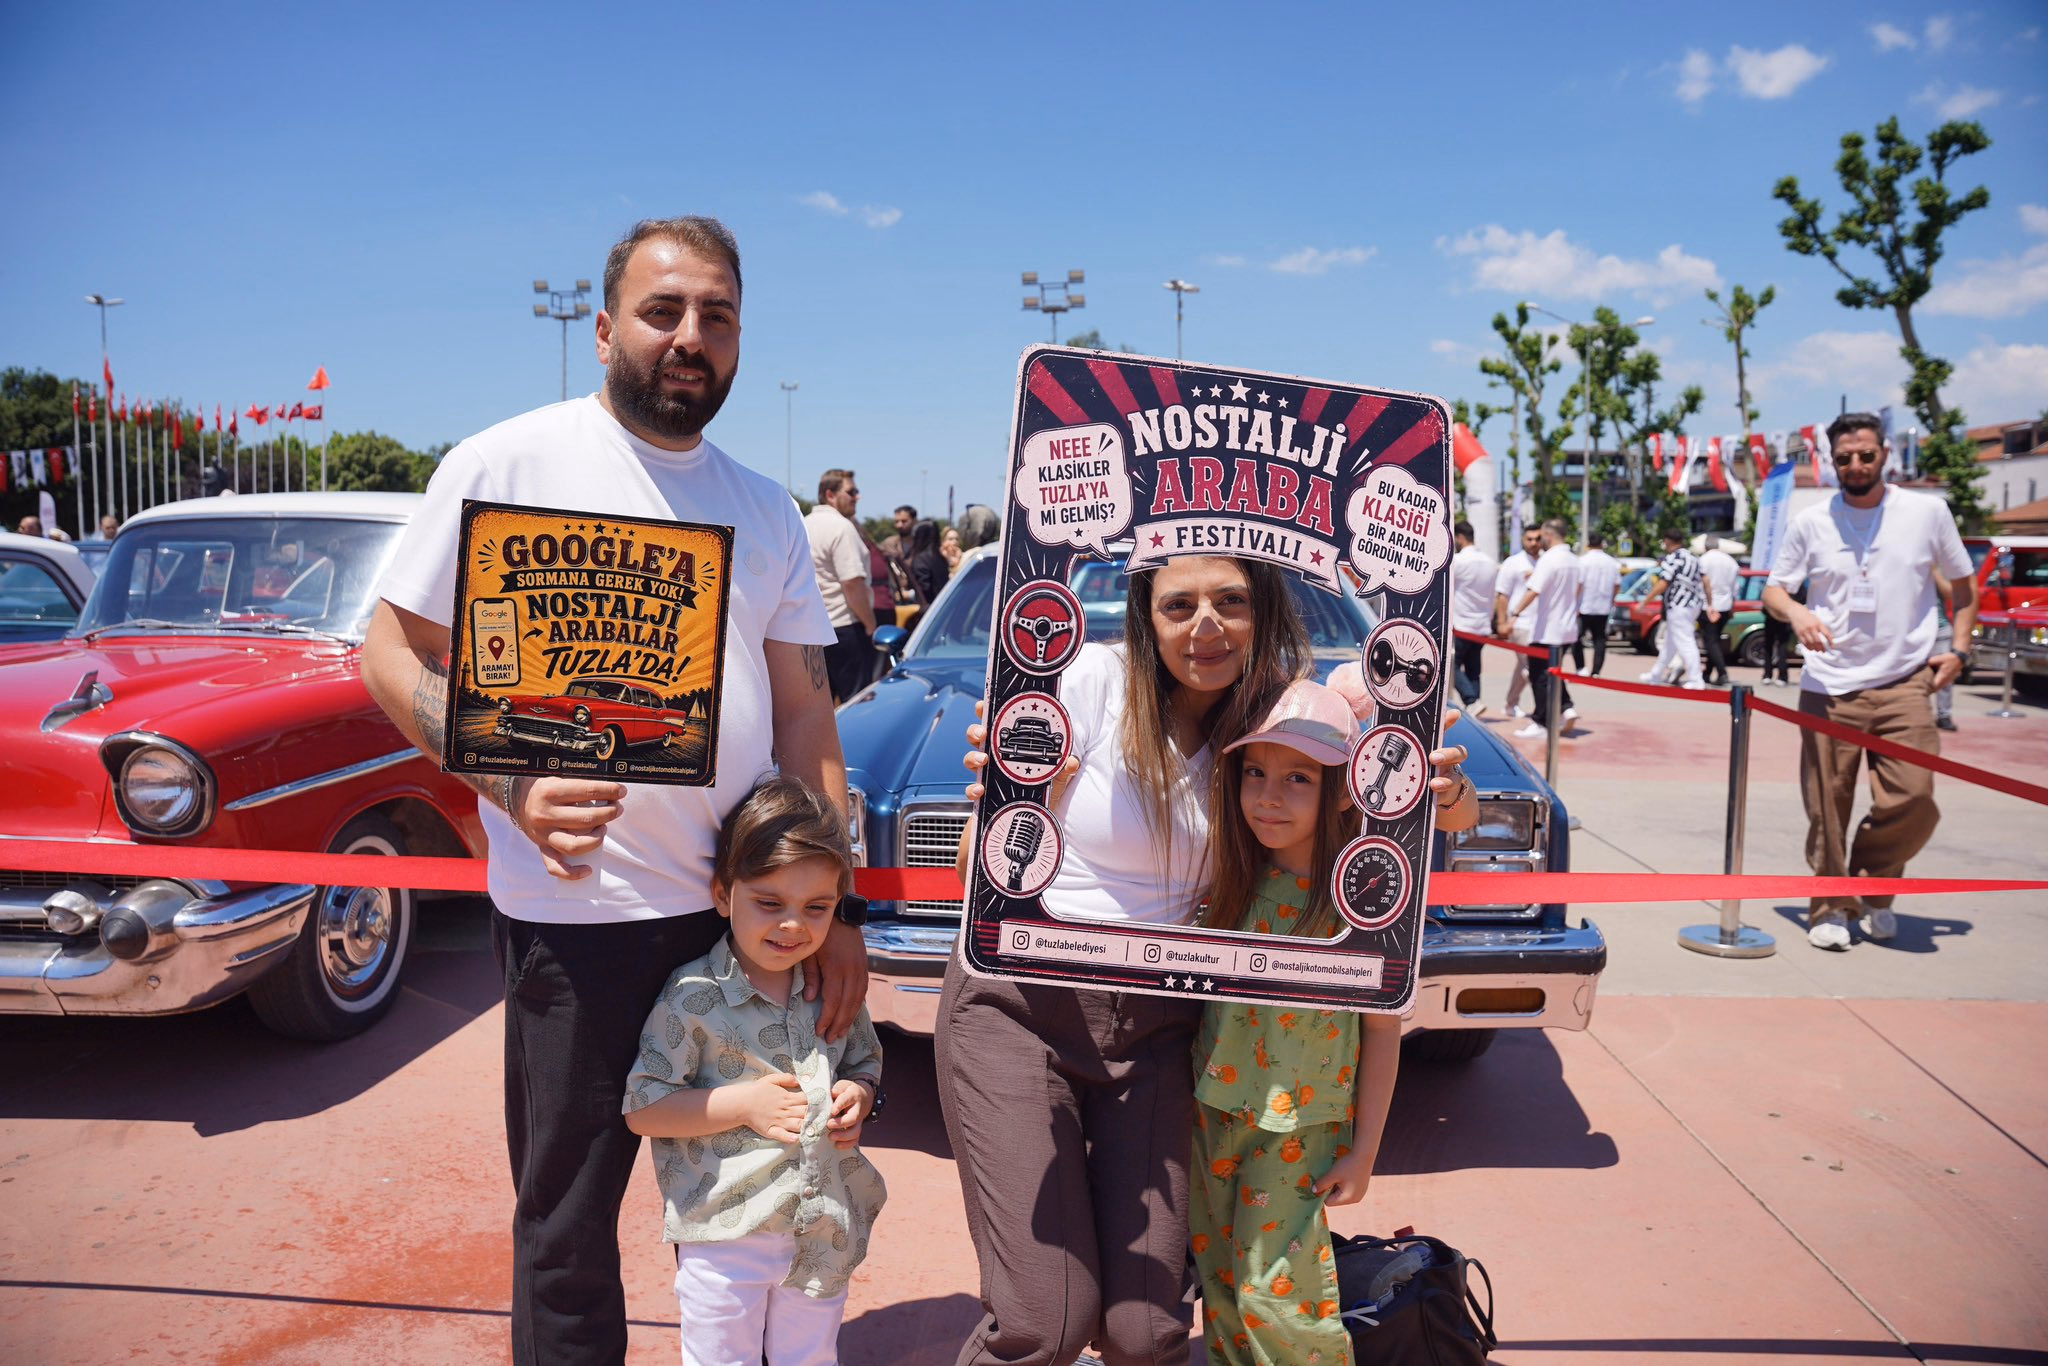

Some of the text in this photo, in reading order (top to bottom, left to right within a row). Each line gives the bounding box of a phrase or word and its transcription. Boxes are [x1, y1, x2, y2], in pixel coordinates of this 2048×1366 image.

[1049, 437, 1092, 460] NEEE
[1127, 404, 1347, 477] NOSTALJİ
[1038, 460, 1110, 482] KLASİKLER
[1039, 481, 1109, 505] TUZLA'YA
[1150, 456, 1334, 537] ARABA
[1378, 481, 1437, 514] BU KADAR
[1041, 501, 1116, 526] Mİ GELMİŞ?
[1362, 496, 1431, 537] KLASİĞİ
[1176, 522, 1302, 561] FESTİVALI
[1367, 523, 1425, 555] BİR ARADA
[1358, 538, 1430, 574] GÖRDÜN MÜ?
[517, 572, 686, 601] SORMANA GEREK YOK!
[481, 610, 508, 619] Google
[526, 591, 683, 631] NOSTALJİ
[548, 620, 680, 655] ARABALAR
[481, 664, 514, 672] ARAMAYI
[486, 672, 511, 680] BIRAK!
[479, 755, 529, 766] @tuzlabelediyesi
[562, 760, 598, 769] @tuzlakultur
[1035, 938, 1107, 954] @tuzlabelediyesi
[1165, 950, 1220, 964] @tuzlakultur
[1272, 960, 1373, 978] @nostaljikotomobilsahipleri
